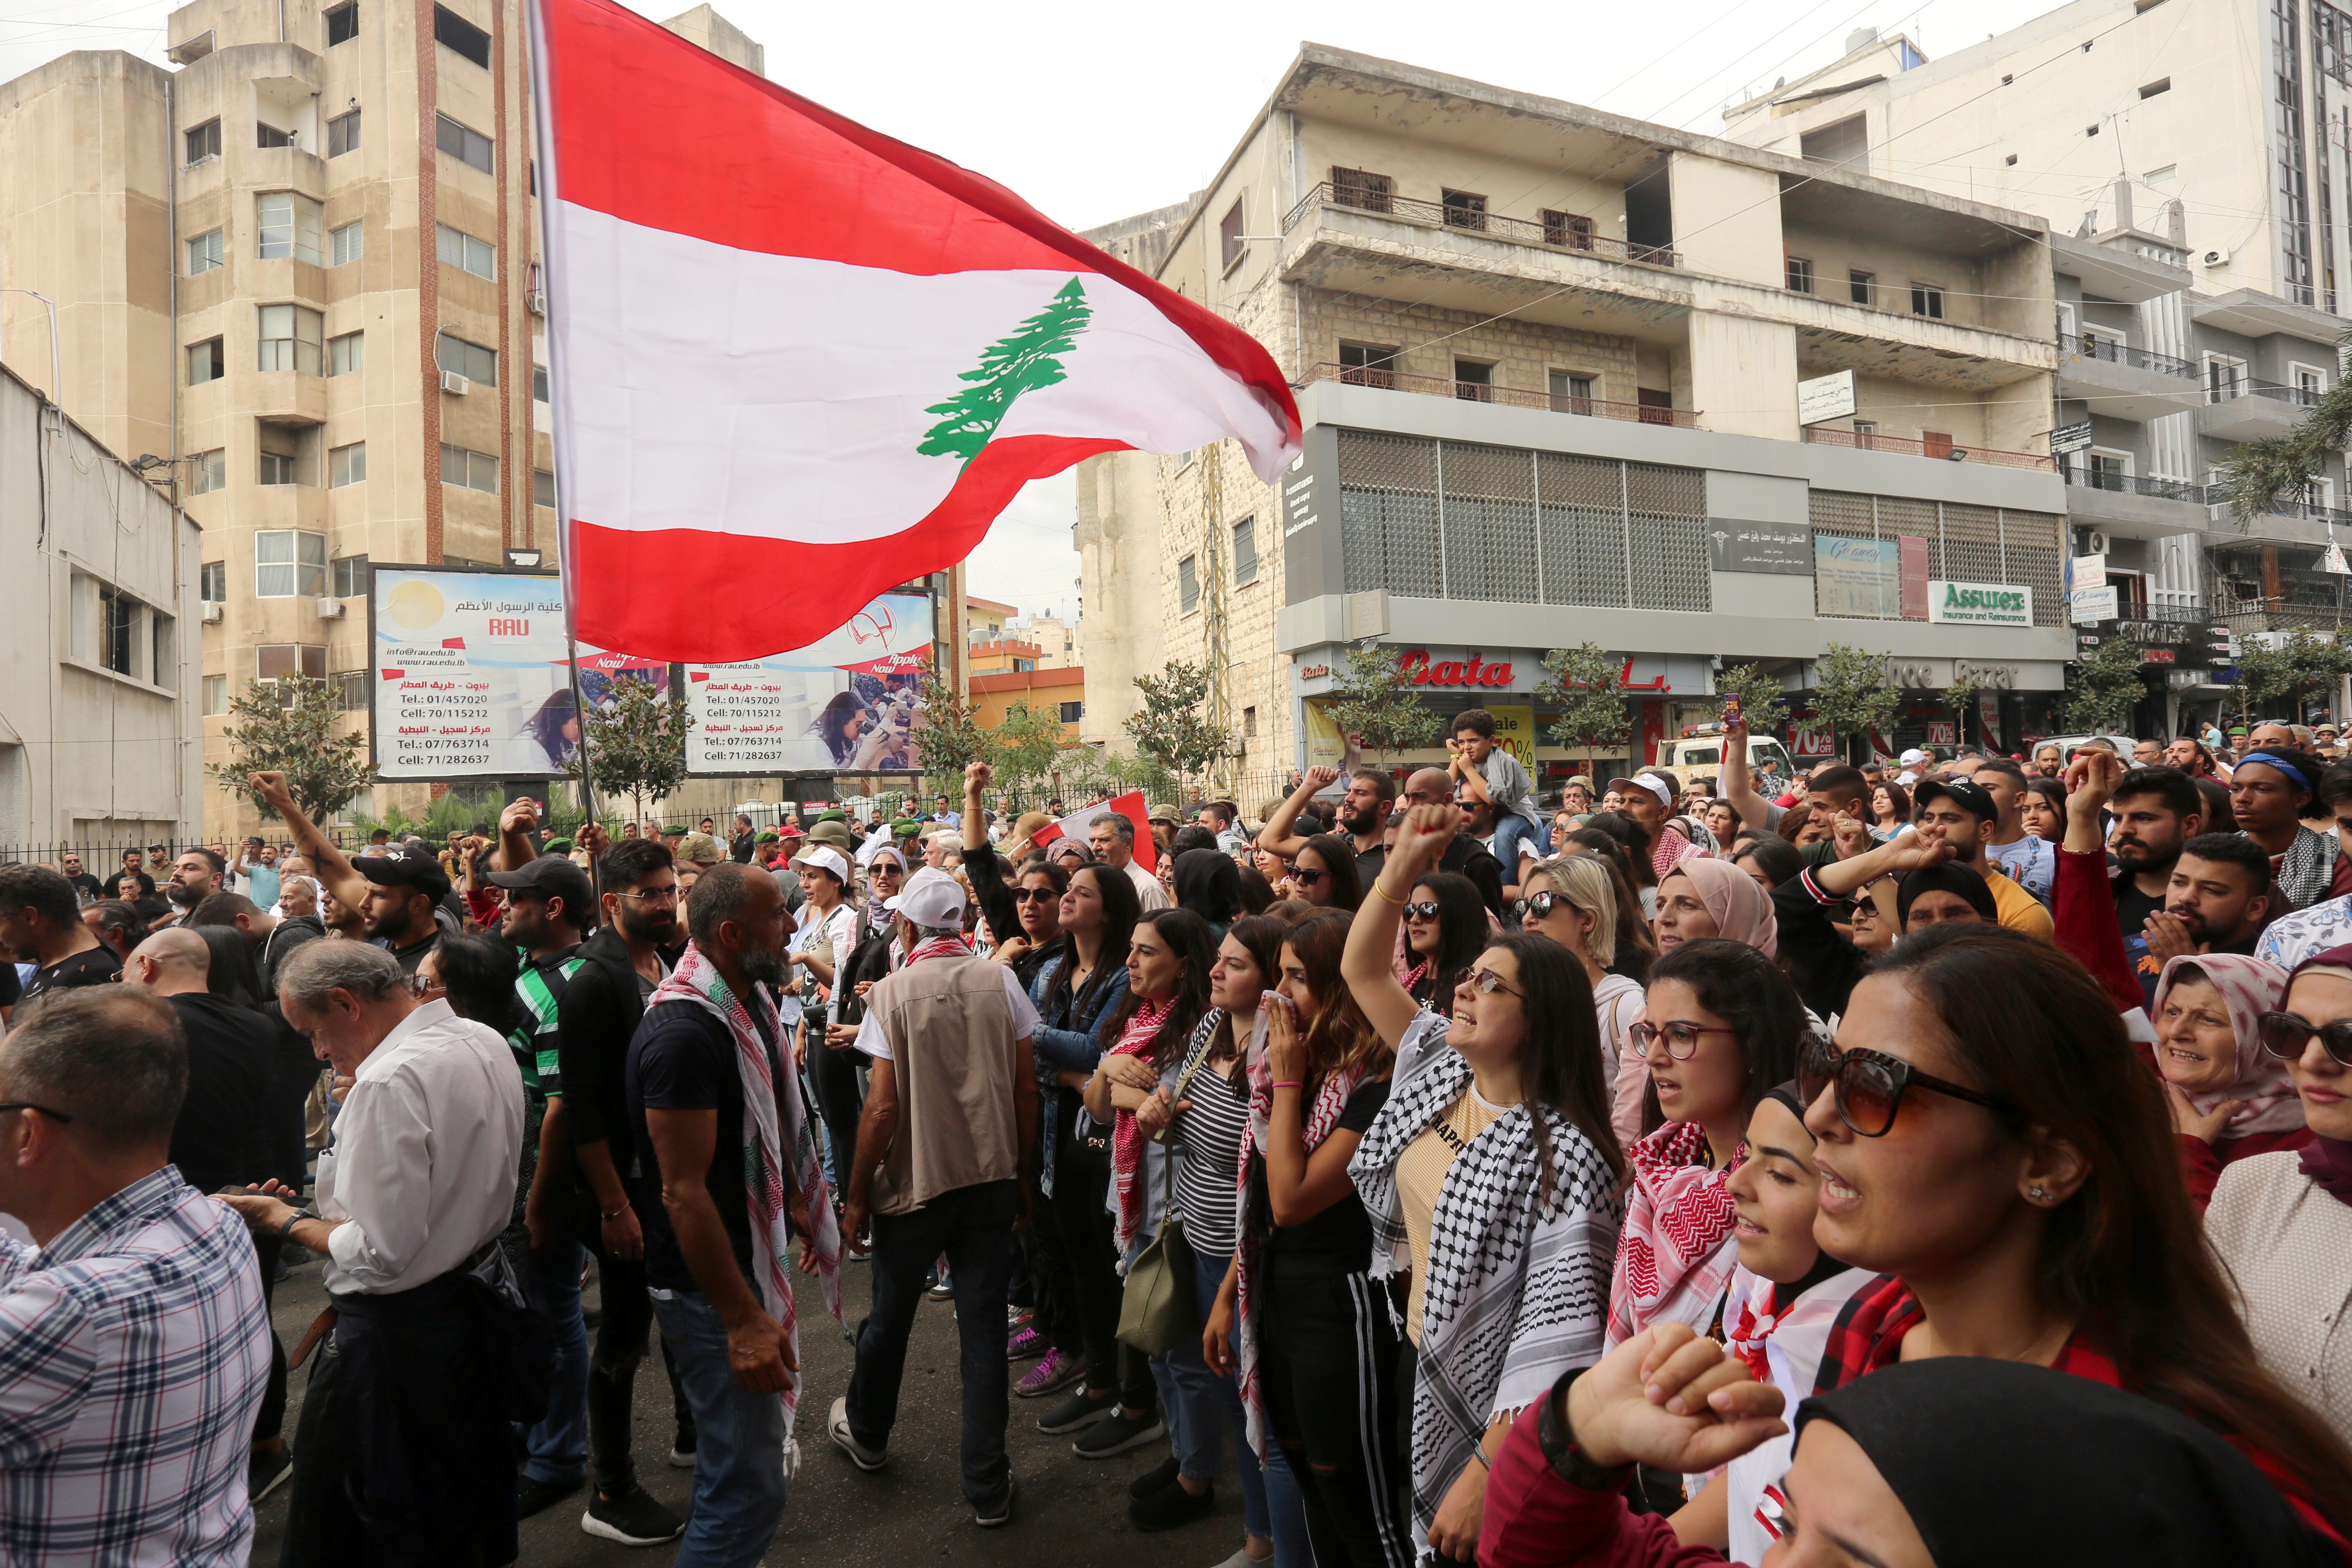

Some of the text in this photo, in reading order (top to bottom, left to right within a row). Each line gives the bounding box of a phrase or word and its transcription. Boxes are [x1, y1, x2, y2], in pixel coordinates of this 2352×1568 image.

[1815, 378, 1839, 390] الدكتور
[1817, 390, 1835, 398] يوسف
[1944, 584, 2025, 610] Assurex
[455, 599, 492, 612] الأعظم
[496, 601, 534, 614] الرسول
[1943, 610, 1973, 619] Insurance
[1989, 612, 2026, 621] Reinsurance
[489, 619, 529, 636] RAU
[386, 648, 455, 656] info@rau.edu.lb
[595, 657, 626, 668] Now
[888, 653, 921, 666] Apply
[871, 663, 896, 673] Now
[1300, 664, 1328, 680] Bata
[1397, 650, 1516, 686] Bata
[1954, 659, 2019, 689] Bazar
[399, 681, 427, 690] المطار
[430, 681, 454, 690] طريق
[466, 682, 489, 691] بيروت
[705, 683, 728, 692] المطار
[731, 683, 752, 692] طريق
[761, 684, 781, 692] بيروت
[401, 695, 487, 704] Tel.: 01/457020
[1981, 702, 1995, 711] Shoe
[401, 709, 488, 717] Cell: 70/115212
[1984, 713, 1999, 722] Bazar
[1496, 717, 1517, 730] ale
[399, 726, 428, 735] النبطية
[440, 726, 467, 735] تسجيل
[470, 726, 491, 735] مركز
[705, 724, 730, 733] النبطية
[739, 724, 763, 733] تسجيل
[765, 724, 783, 733] مركز
[1930, 724, 1953, 743] 70%
[398, 740, 489, 748] Tel.: 07/763714
[398, 755, 489, 764] Cell: 71/282637
[705, 751, 782, 760] Cell: 71/282637
[1392, 768, 1414, 779] Ba
